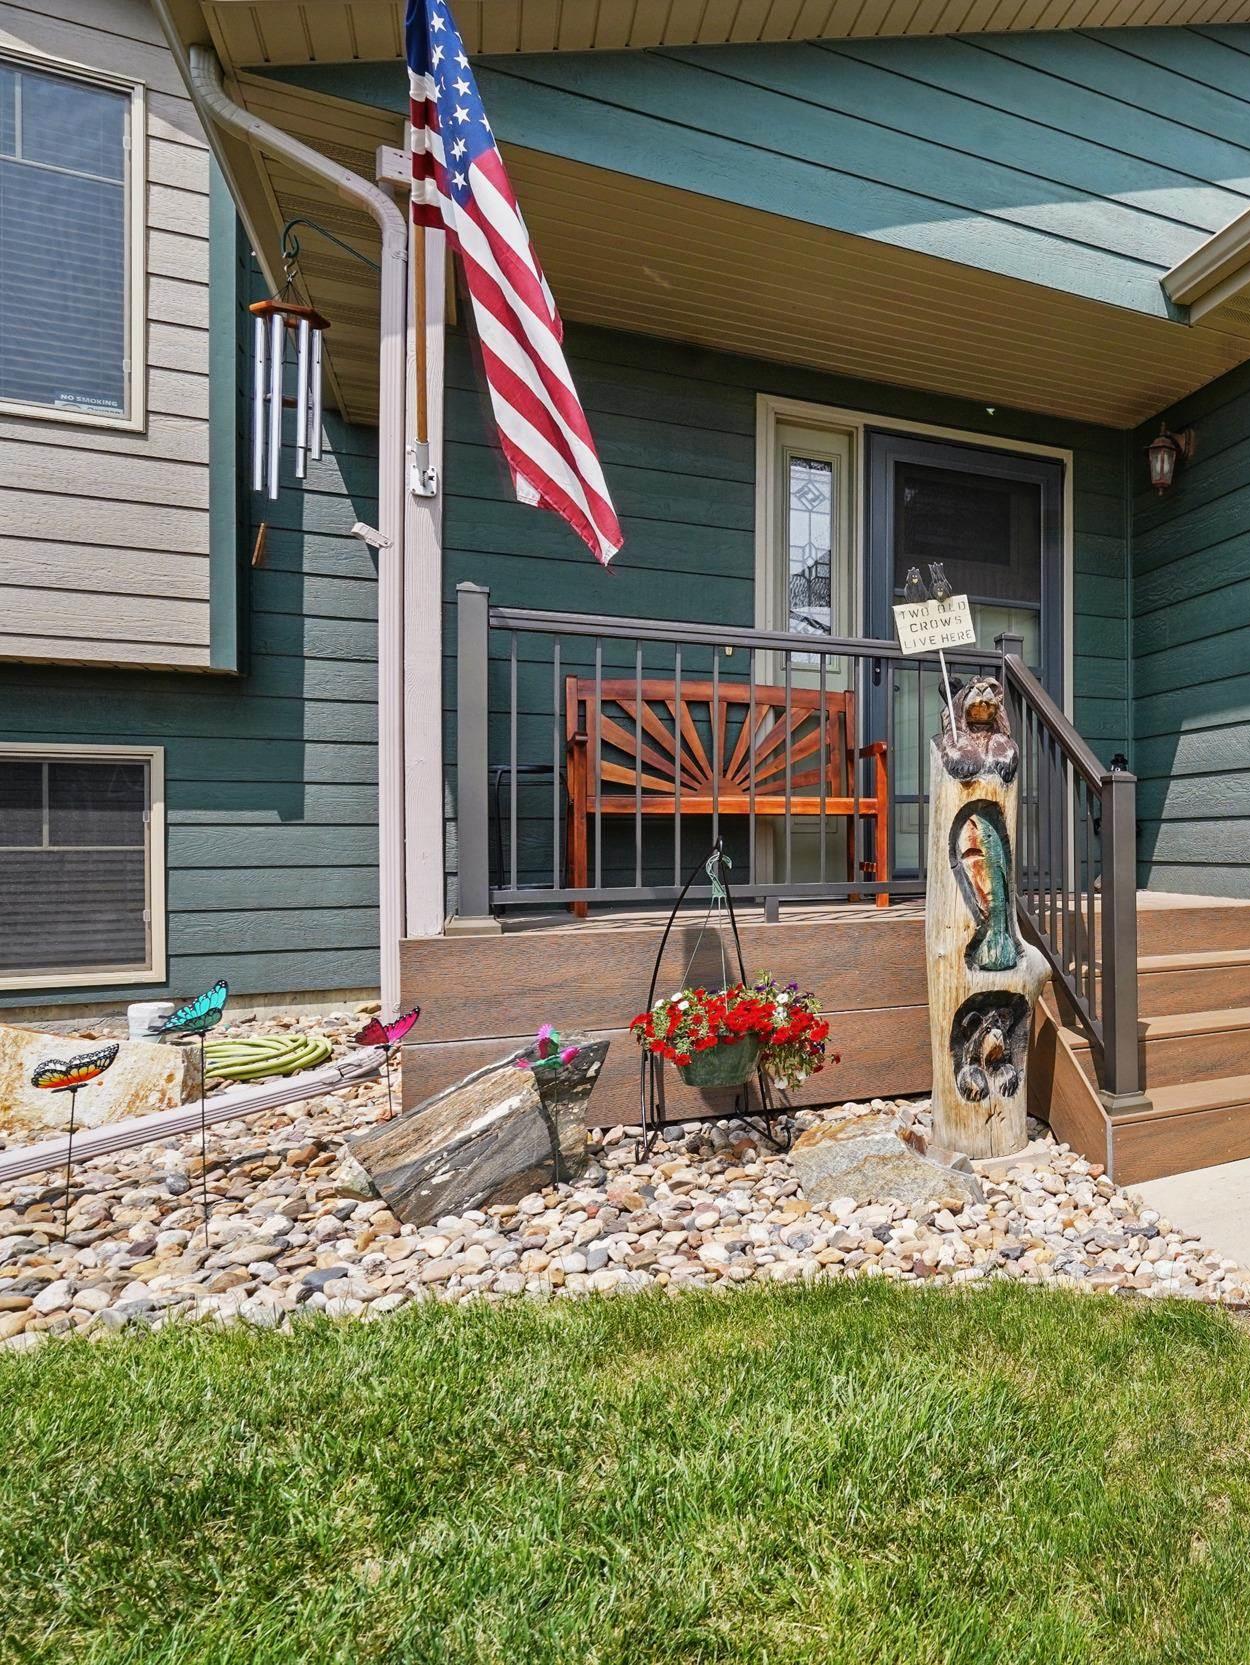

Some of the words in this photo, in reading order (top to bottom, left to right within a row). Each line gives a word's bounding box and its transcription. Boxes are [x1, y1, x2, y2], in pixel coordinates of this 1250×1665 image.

[76, 396, 118, 407] SMOKING
[900, 607, 930, 620] TWO
[937, 601, 966, 614] OLD
[910, 615, 962, 633] CROWS
[904, 635, 937, 649] LIVE
[941, 629, 973, 643] HERE
